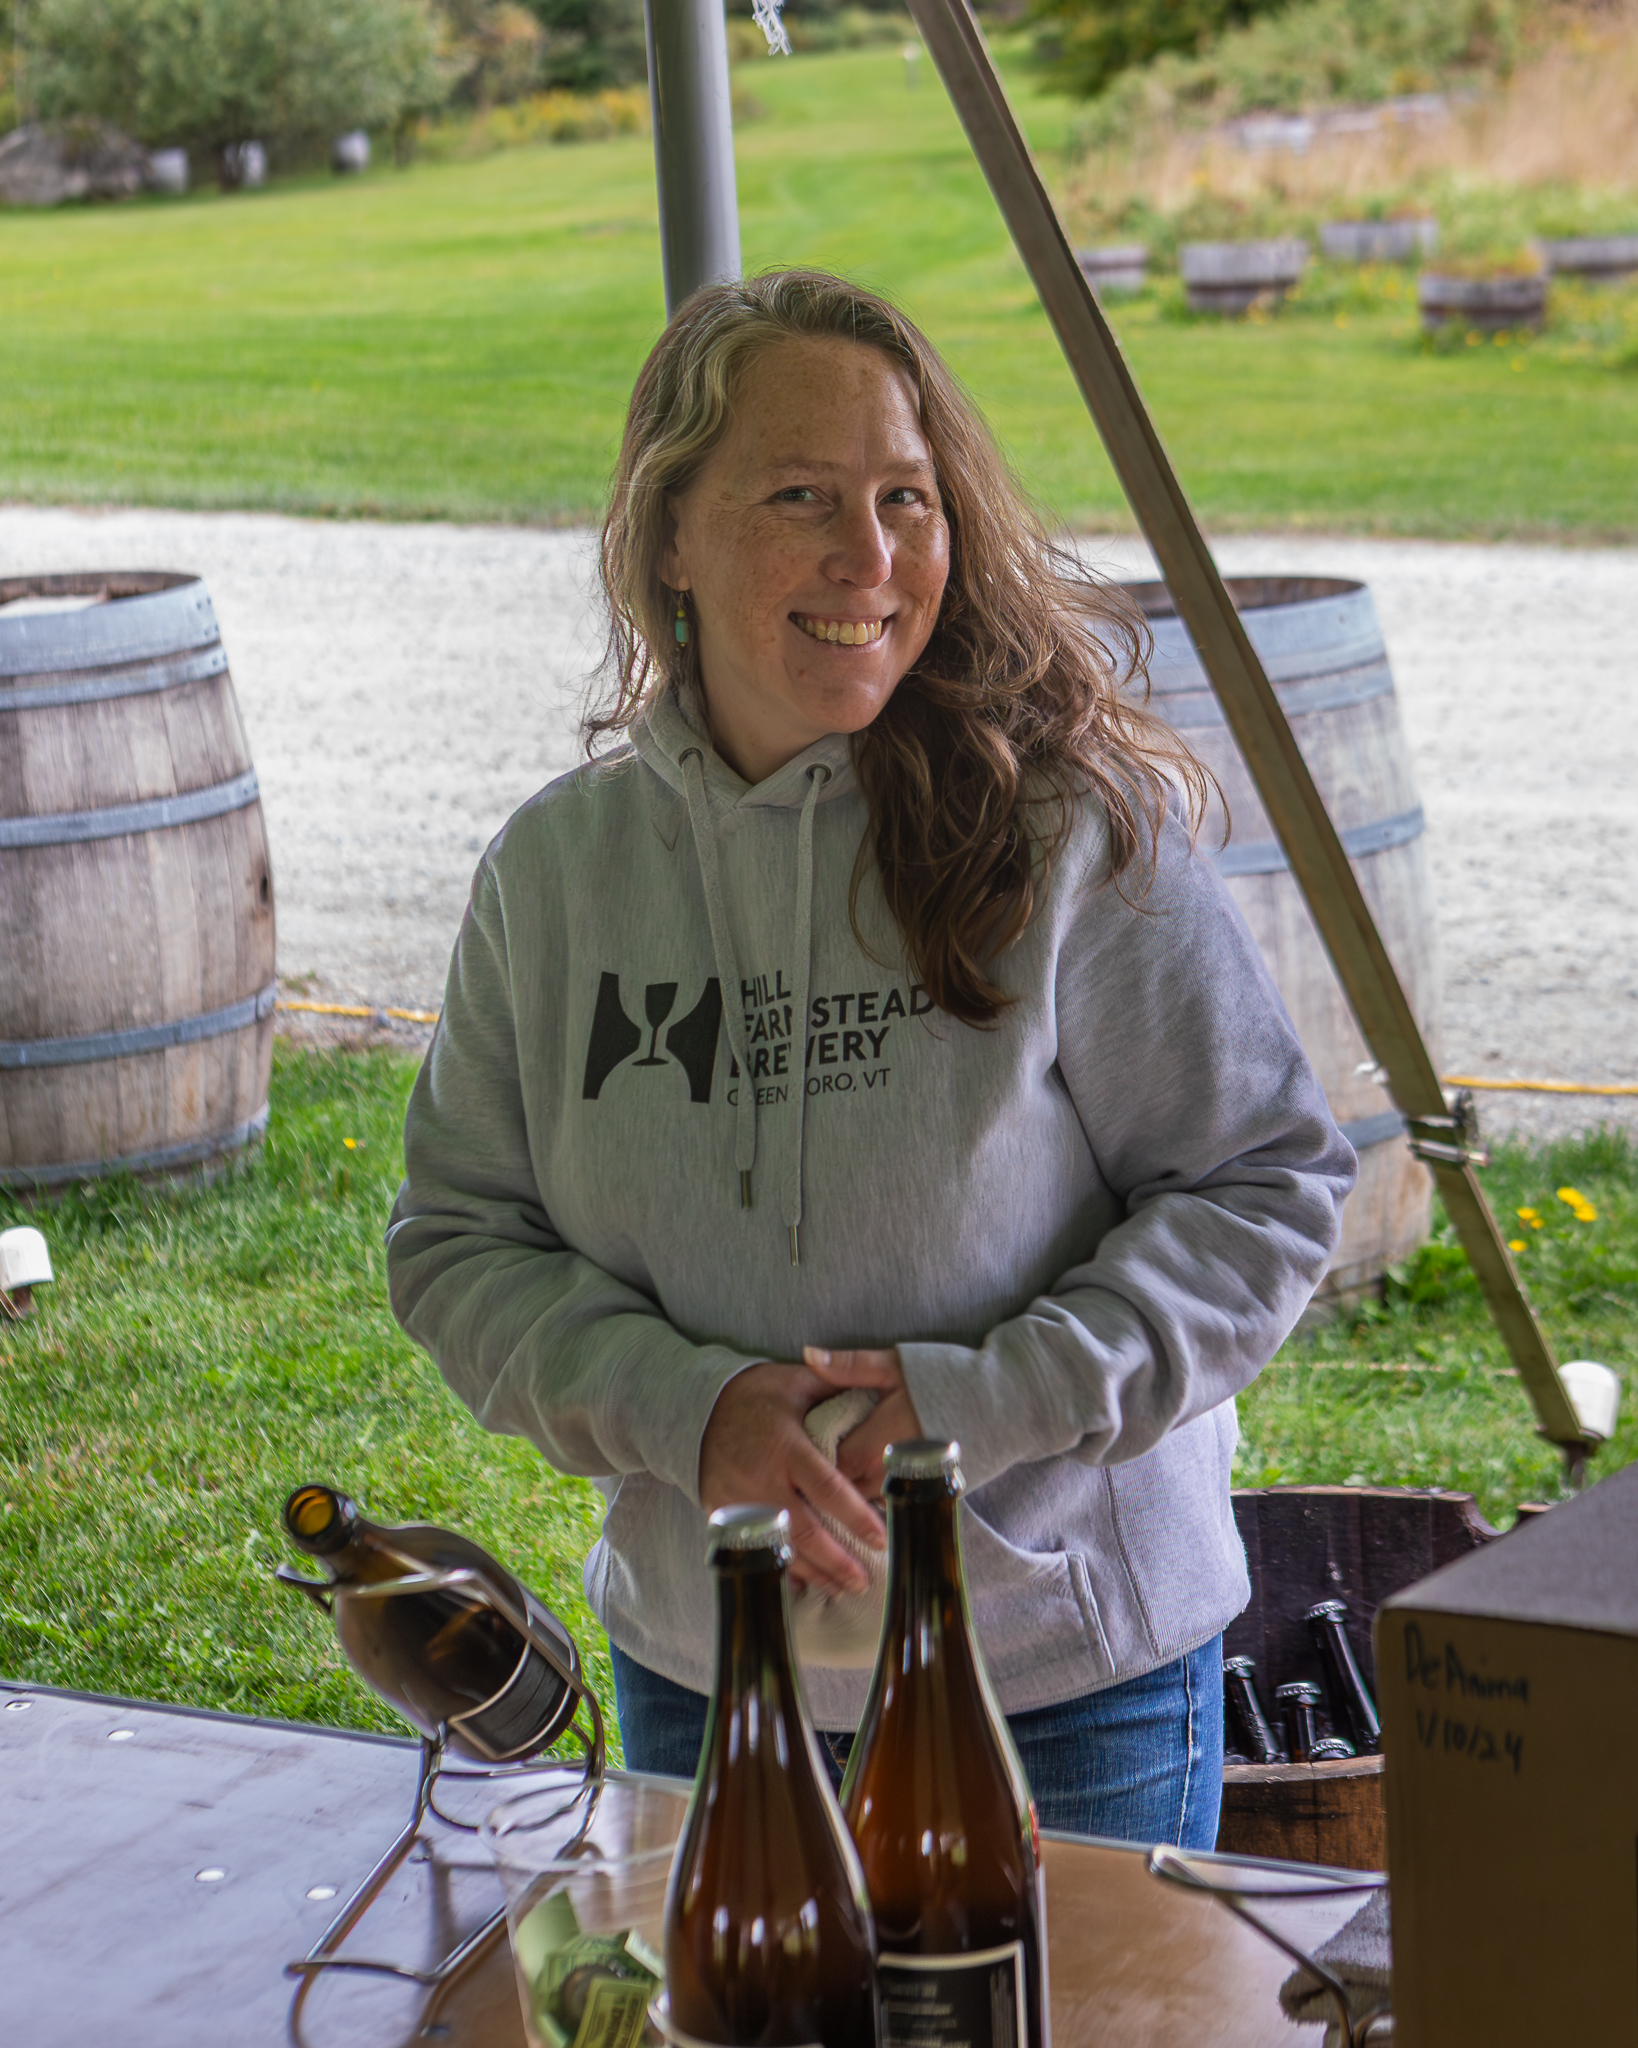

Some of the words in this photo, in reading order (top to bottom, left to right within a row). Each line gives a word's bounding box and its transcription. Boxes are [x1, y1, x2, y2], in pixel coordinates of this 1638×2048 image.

[741, 970, 792, 1008] HILL
[863, 1067, 891, 1089] VT
[1416, 1707, 1524, 1775] 1/10/24
